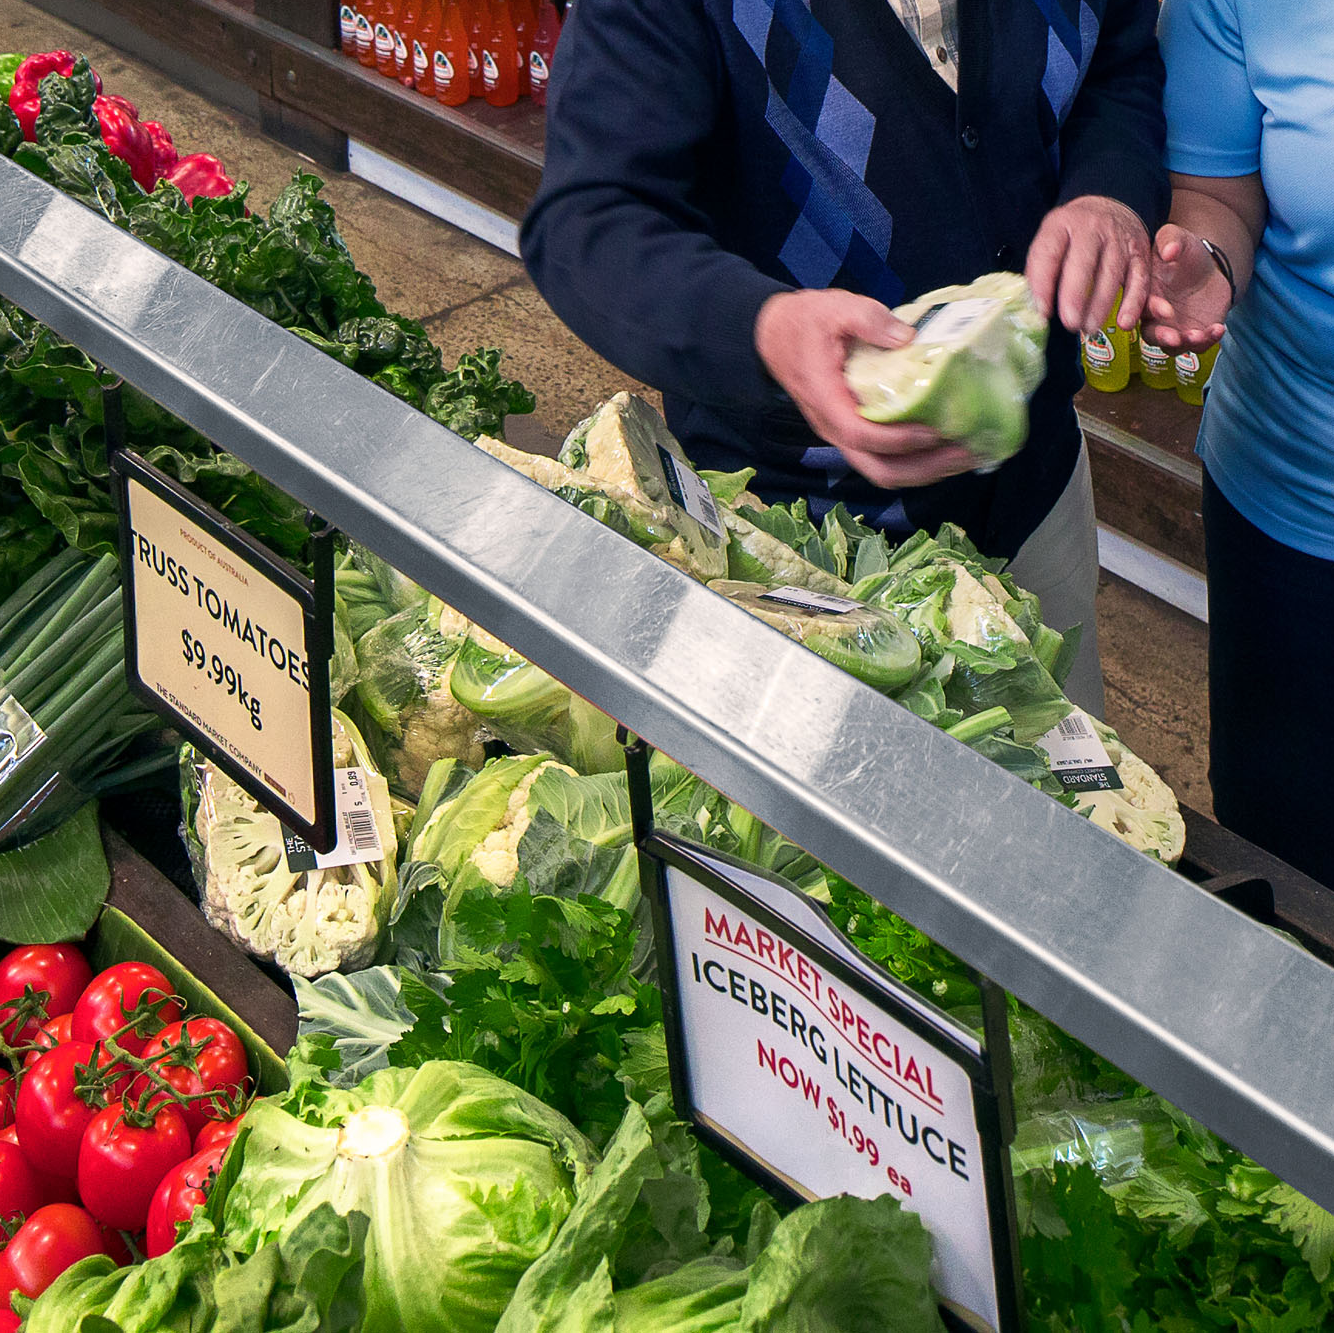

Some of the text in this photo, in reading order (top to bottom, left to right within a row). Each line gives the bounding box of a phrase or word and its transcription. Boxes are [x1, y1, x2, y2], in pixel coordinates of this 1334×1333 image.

[131, 528, 310, 693] TRUSS TOMATOES
[180, 528, 208, 555] PRODUCT
[216, 557, 249, 587] AUSTRALIA
[156, 682, 262, 777] THE STANDARD MARKET COMPANY
[181, 629, 263, 731] $9.99kg
[1063, 773, 1107, 784] STANDARD
[689, 950, 972, 1183] ICEBERG LETTUCE
[703, 905, 945, 1107] MARKET SPECIAL
[755, 1038, 915, 1199] NOW $1.99 ea
